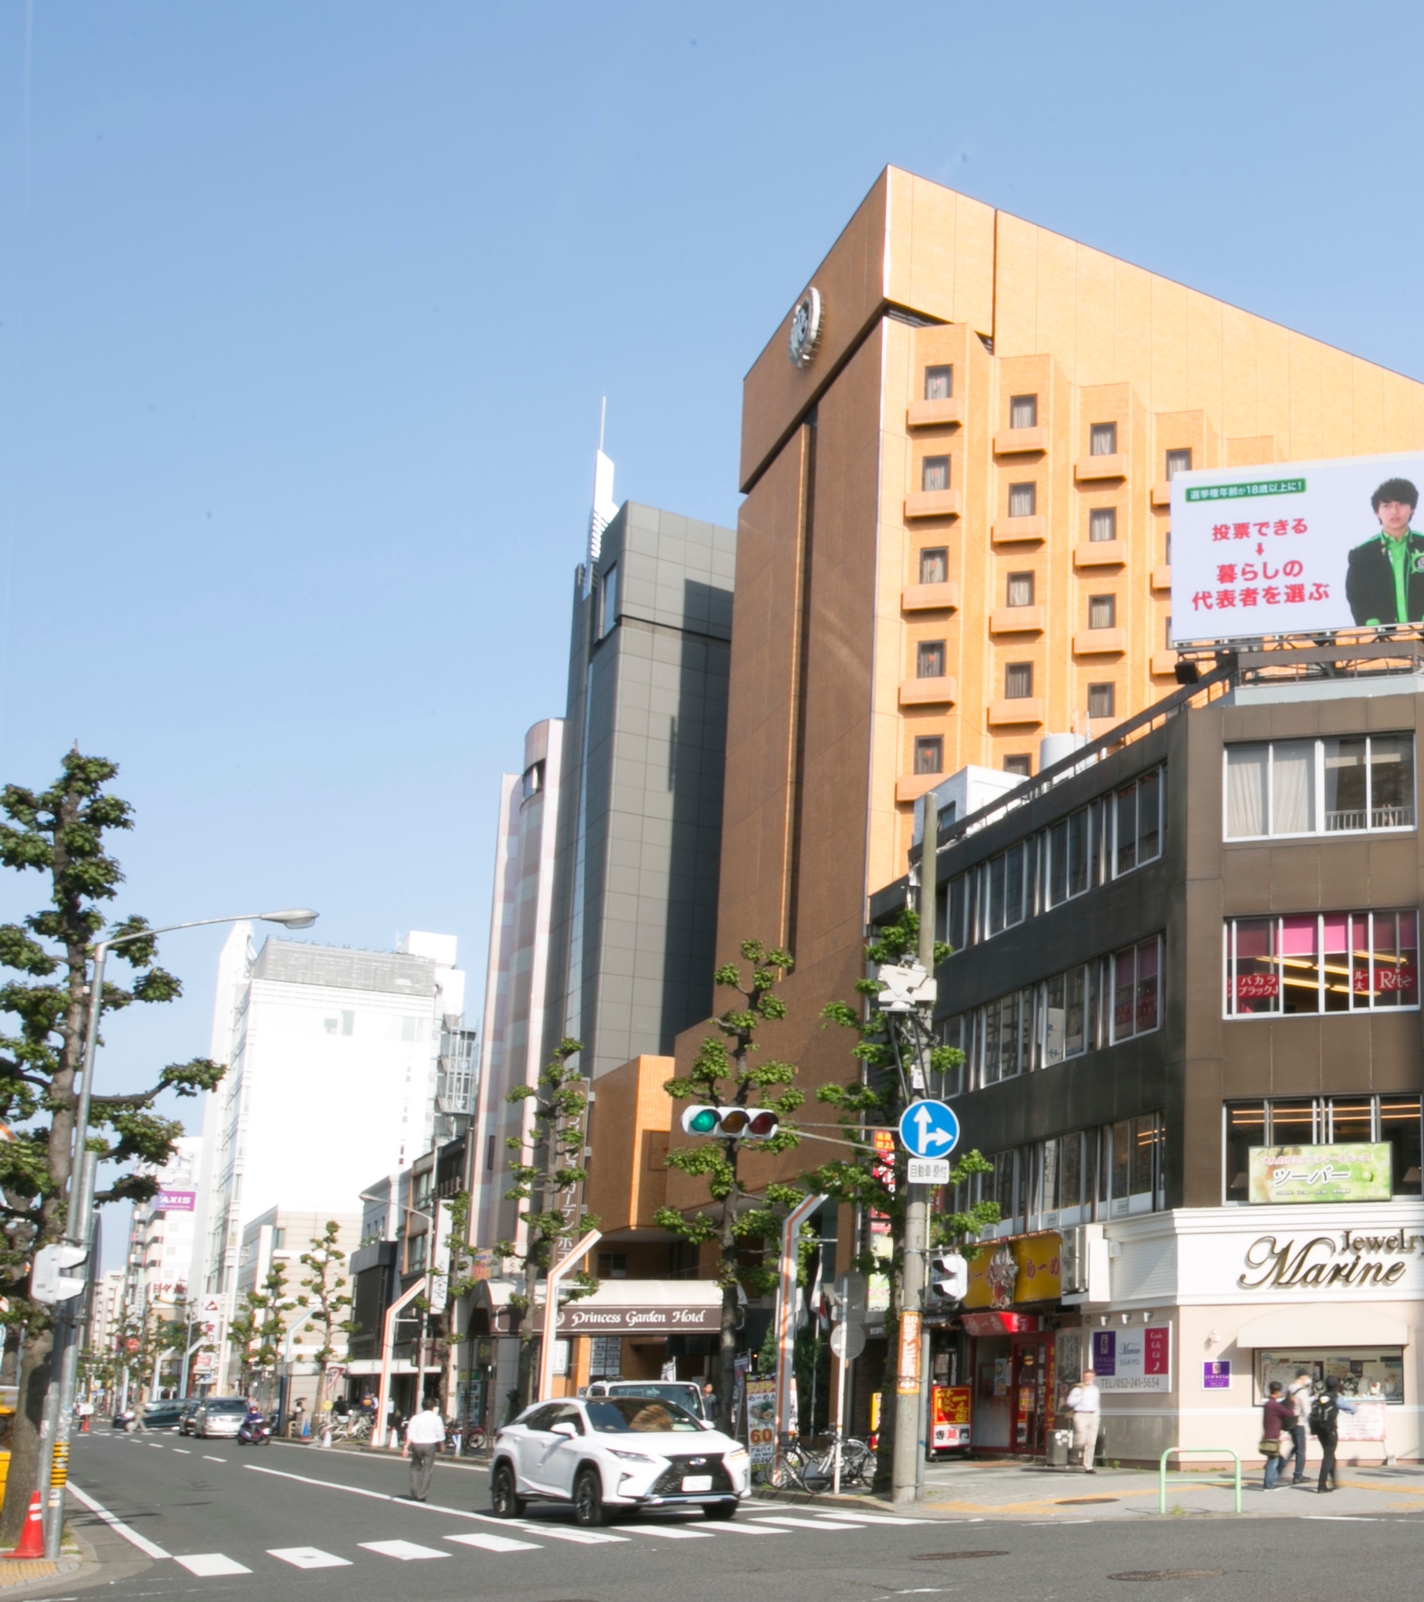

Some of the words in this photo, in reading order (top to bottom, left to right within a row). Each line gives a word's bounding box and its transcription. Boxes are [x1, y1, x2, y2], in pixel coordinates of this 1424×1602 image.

[1212, 518, 1308, 542] 投票できる
[1216, 559, 1304, 584] 暮らしの
[1191, 582, 1330, 612] 代表者を選ぶ
[1379, 967, 1413, 989] Ritz
[1273, 1165, 1351, 1187] ツーバー
[160, 1195, 192, 1205] AXIS
[1239, 1236, 1407, 1288] Marine
[571, 1310, 621, 1328] Princess
[625, 1310, 667, 1327] Garden
[672, 1308, 706, 1324] Hotel
